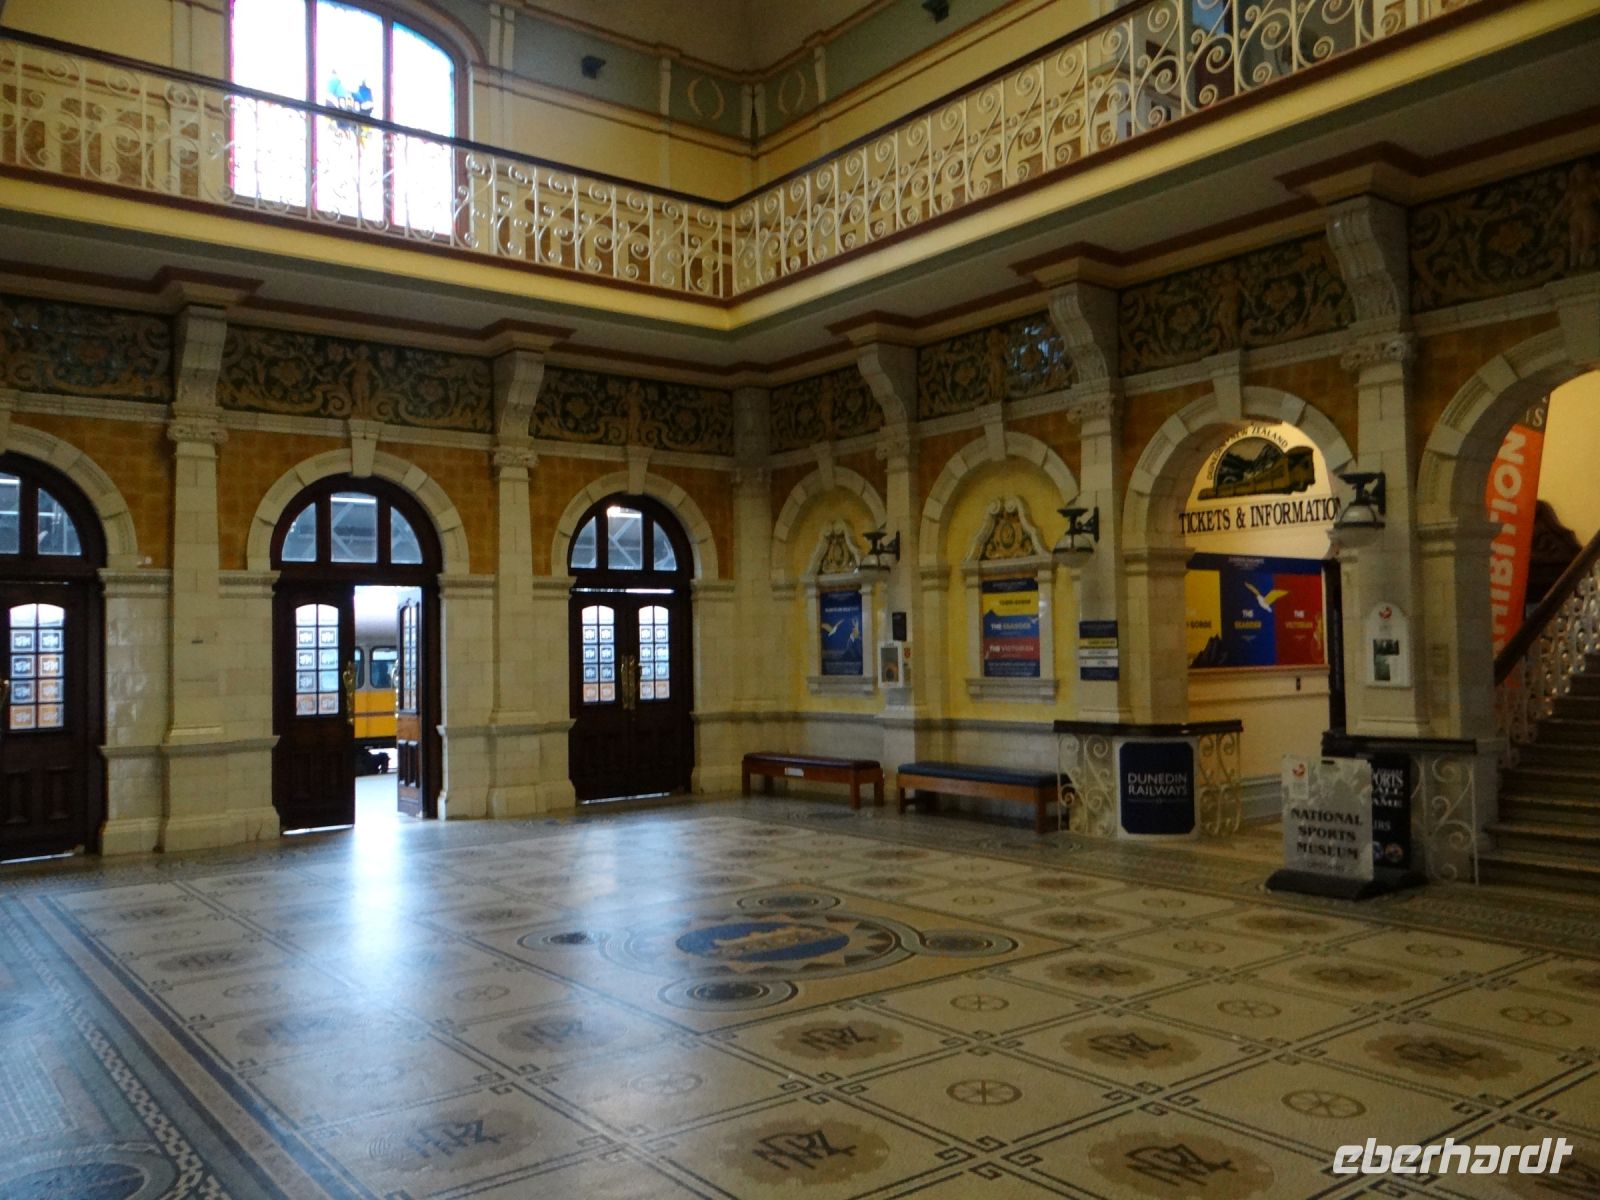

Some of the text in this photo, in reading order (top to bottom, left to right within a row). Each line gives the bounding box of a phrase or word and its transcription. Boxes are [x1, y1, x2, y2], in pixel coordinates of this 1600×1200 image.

[1252, 426, 1288, 448] ZEALAND
[1179, 507, 1230, 535] TICKETS
[1236, 507, 1246, 528] &
[1127, 773, 1187, 785] DUNEDIN
[1128, 785, 1187, 797] RAILWAYS
[1291, 808, 1363, 826] NATIONAL
[1298, 826, 1356, 841] SPORTS
[1297, 842, 1358, 860] MUSEUM
